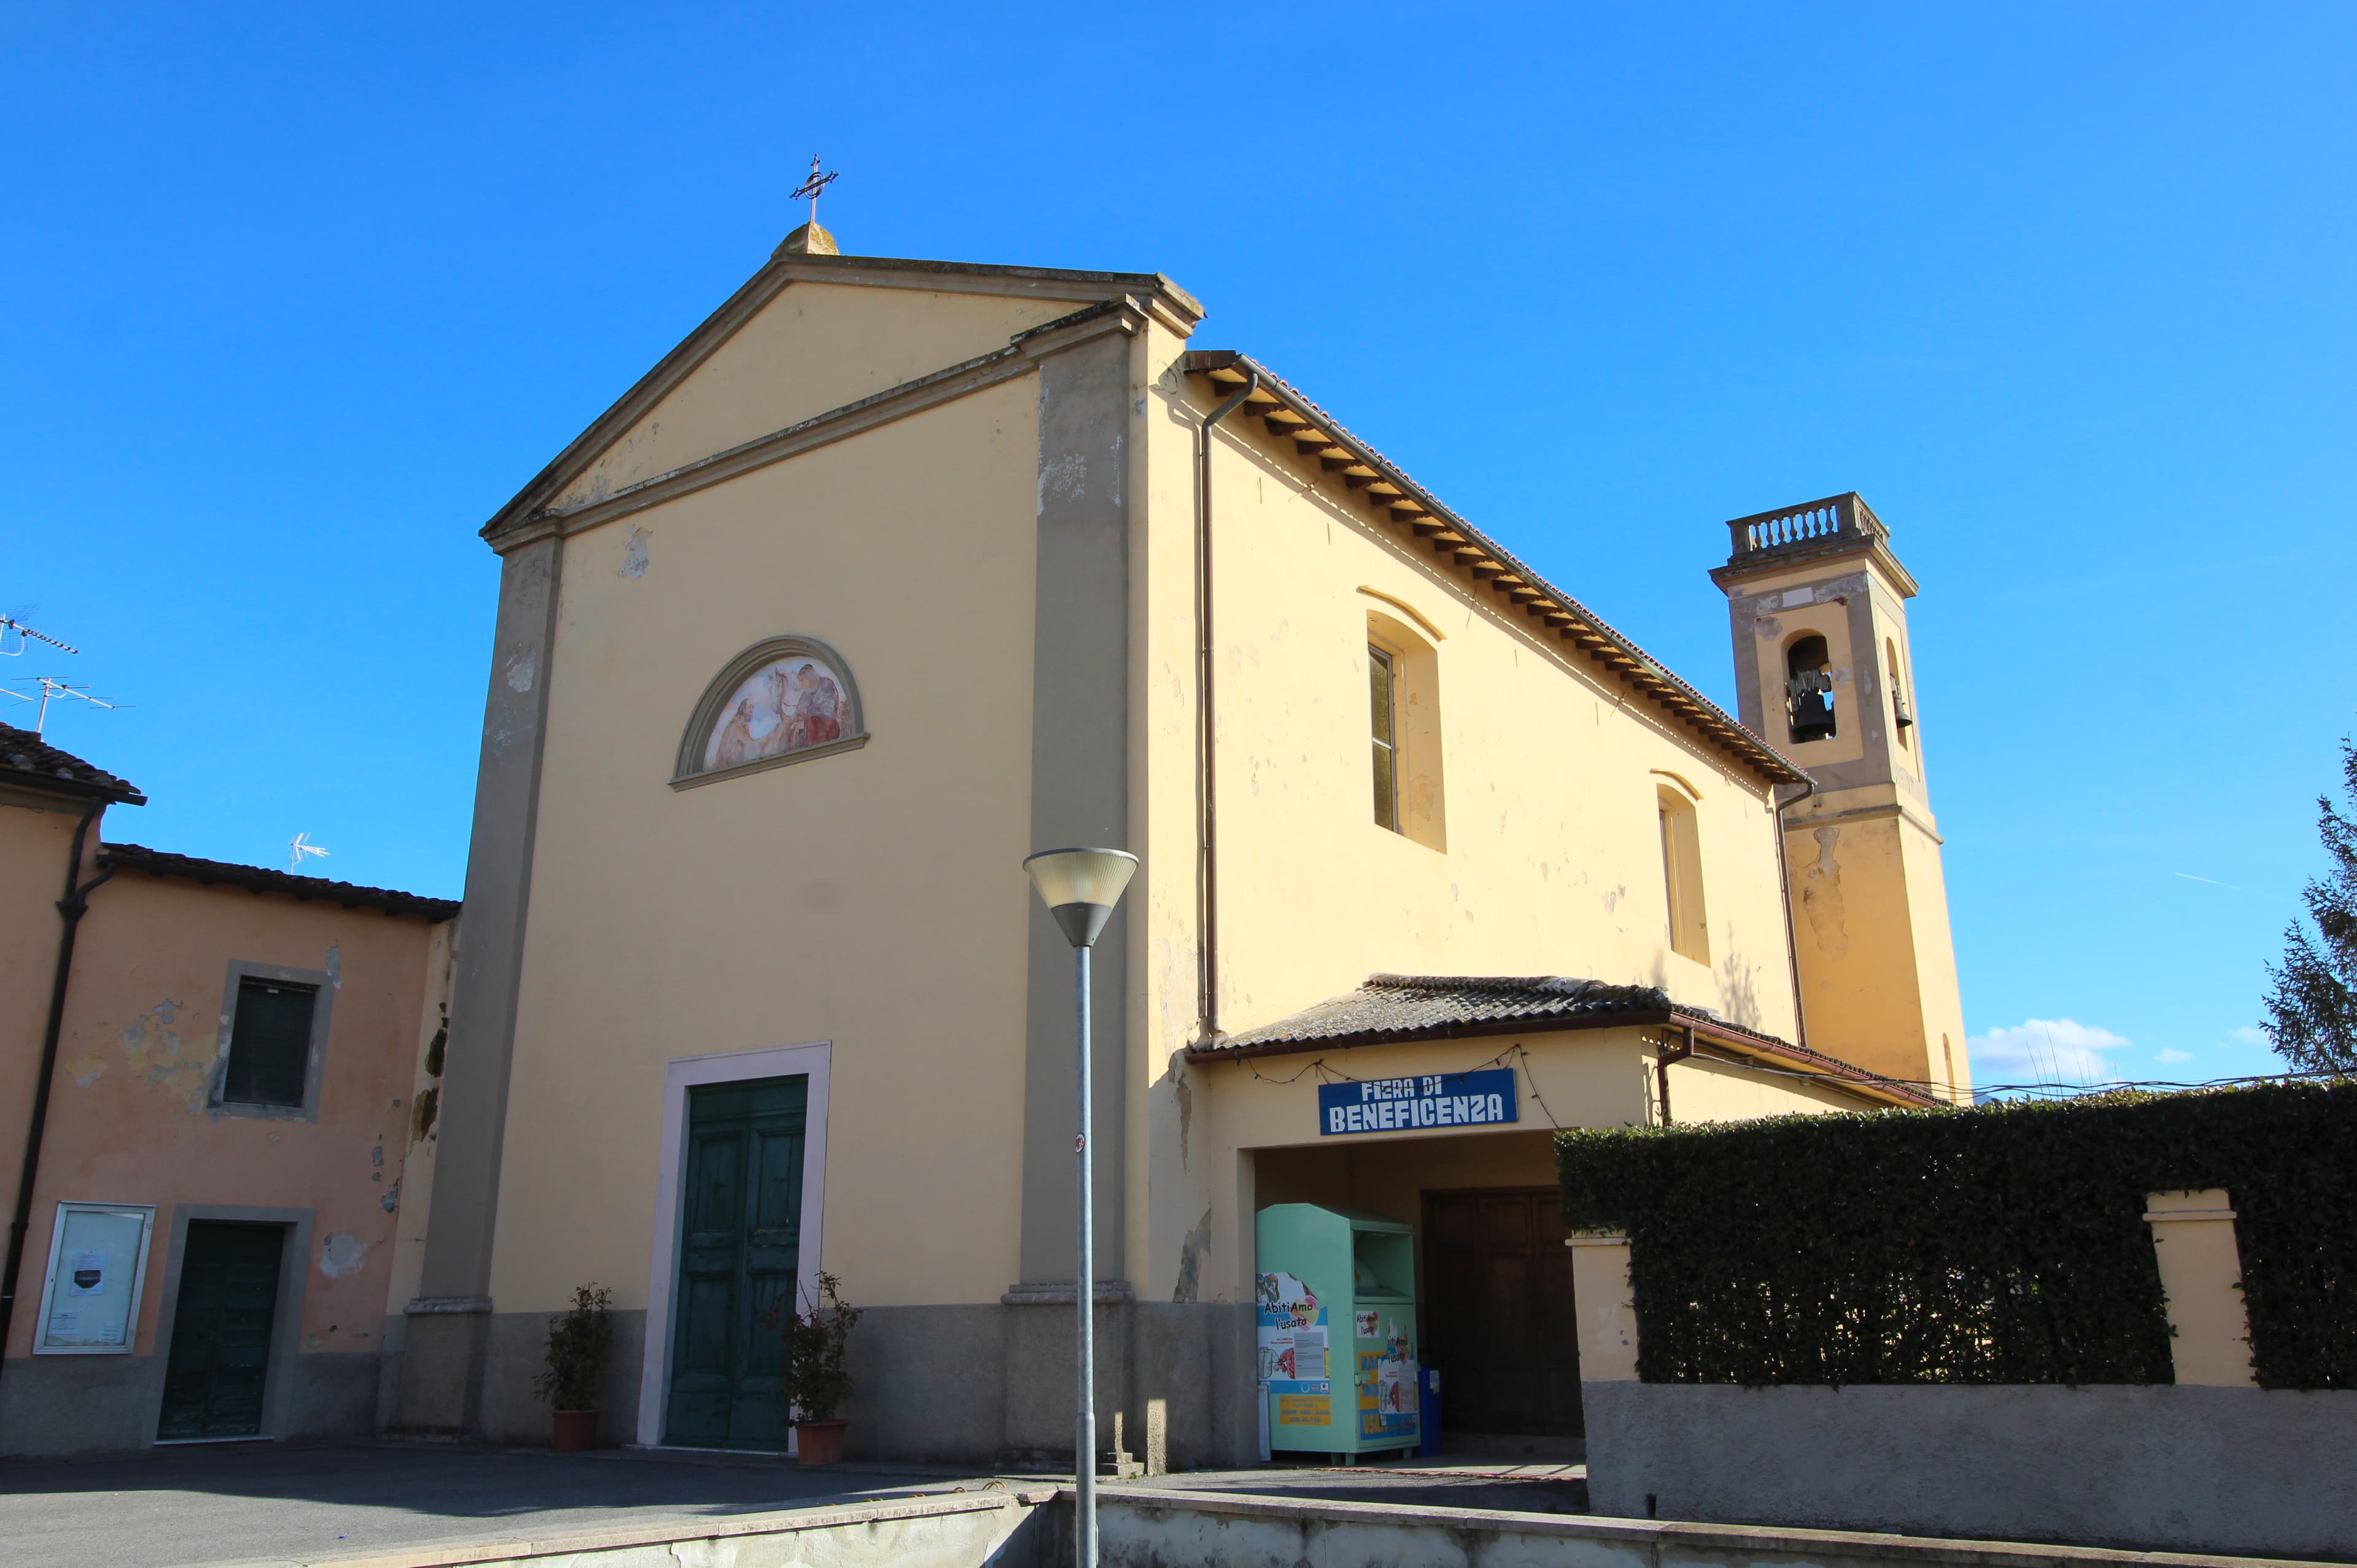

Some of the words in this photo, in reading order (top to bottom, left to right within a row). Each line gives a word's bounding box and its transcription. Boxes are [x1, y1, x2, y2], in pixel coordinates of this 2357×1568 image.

[1361, 1078, 1415, 1101] FIERA
[1423, 1075, 1442, 1095] DI
[1329, 1094, 1503, 1132] BENEFICENZA
[1264, 1302, 1313, 1314] AbitiAmo
[1275, 1318, 1307, 1330] l'usato
